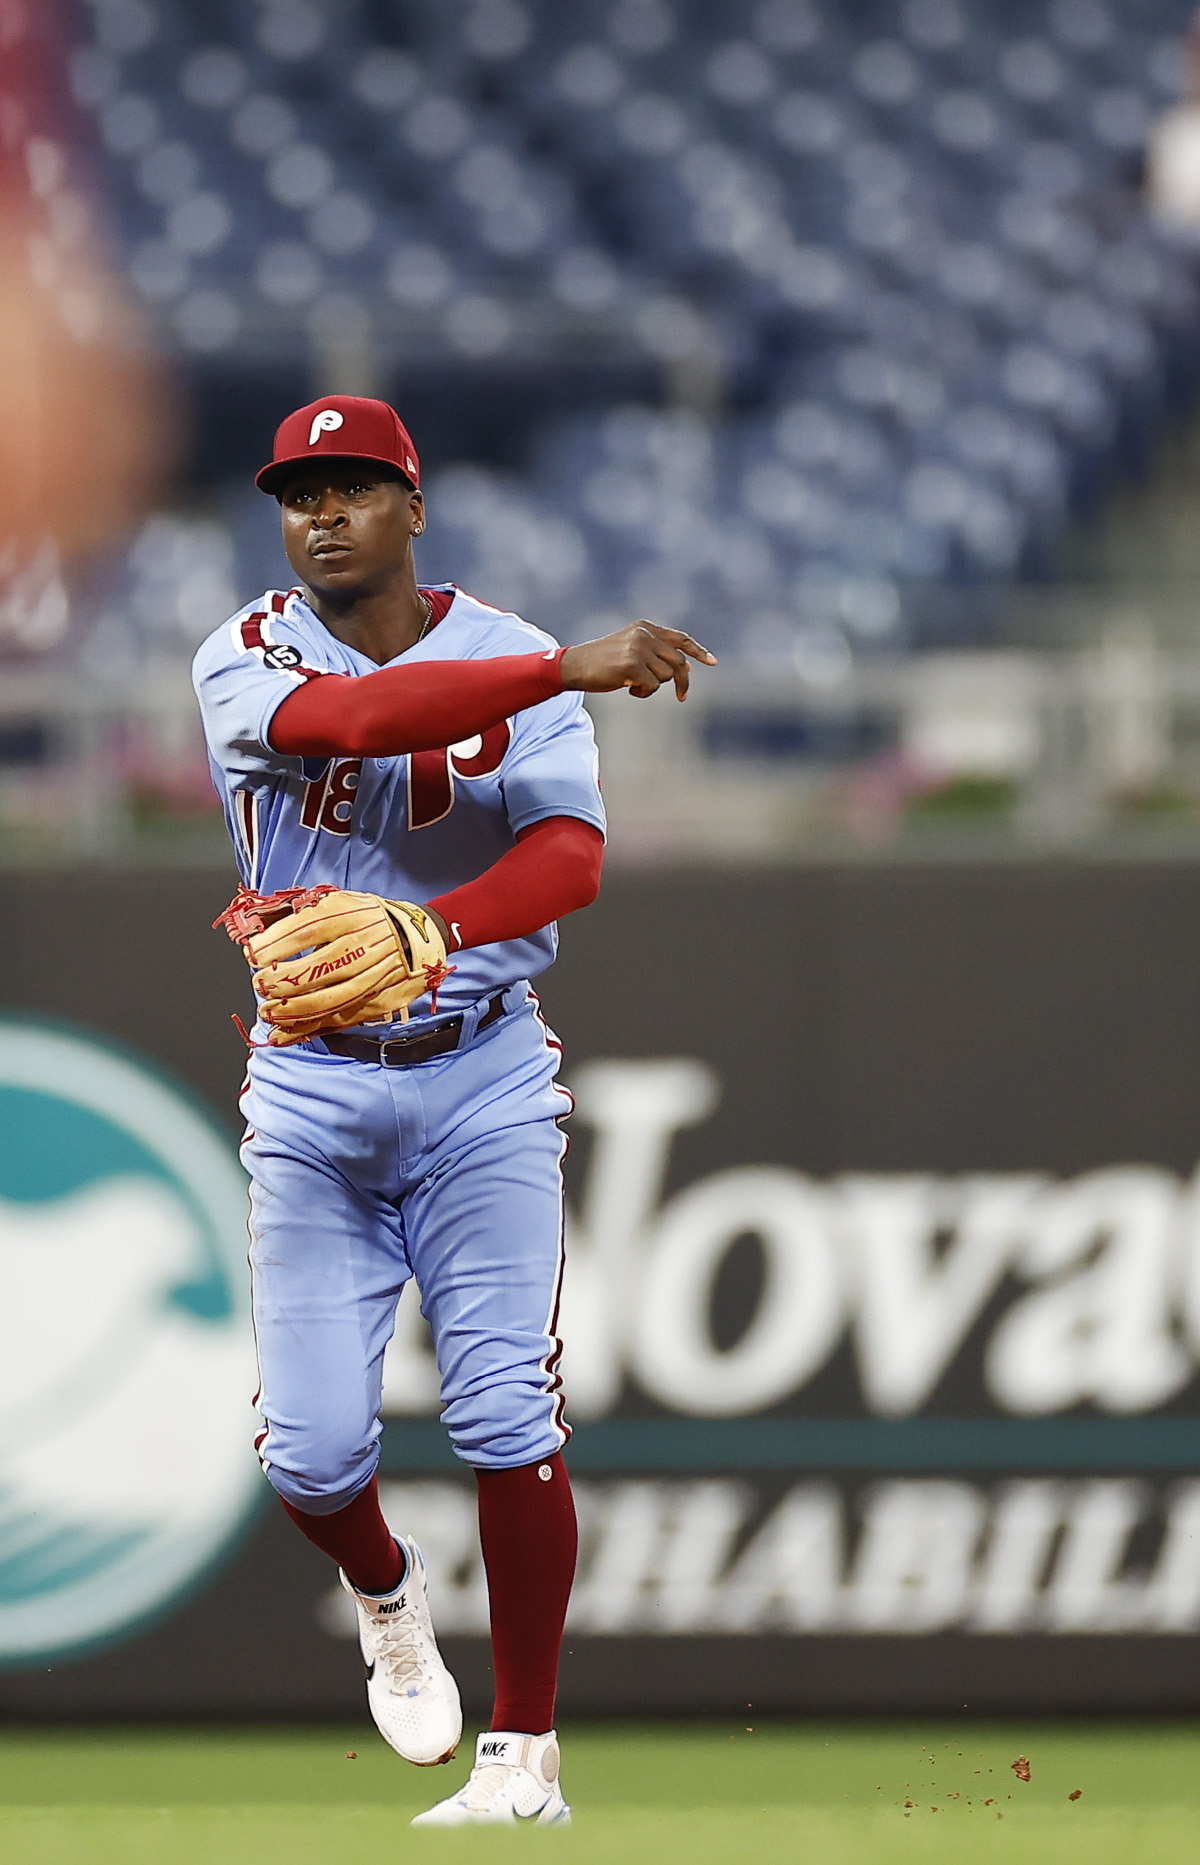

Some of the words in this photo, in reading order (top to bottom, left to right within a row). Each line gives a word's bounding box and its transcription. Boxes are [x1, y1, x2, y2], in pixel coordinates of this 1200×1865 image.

[309, 409, 343, 446] P
[265, 645, 298, 669] 15
[300, 757, 363, 836] 18
[308, 946, 366, 982] Mizuno
[378, 1592, 407, 1614] NIKE
[479, 1741, 510, 1757] NIKE
